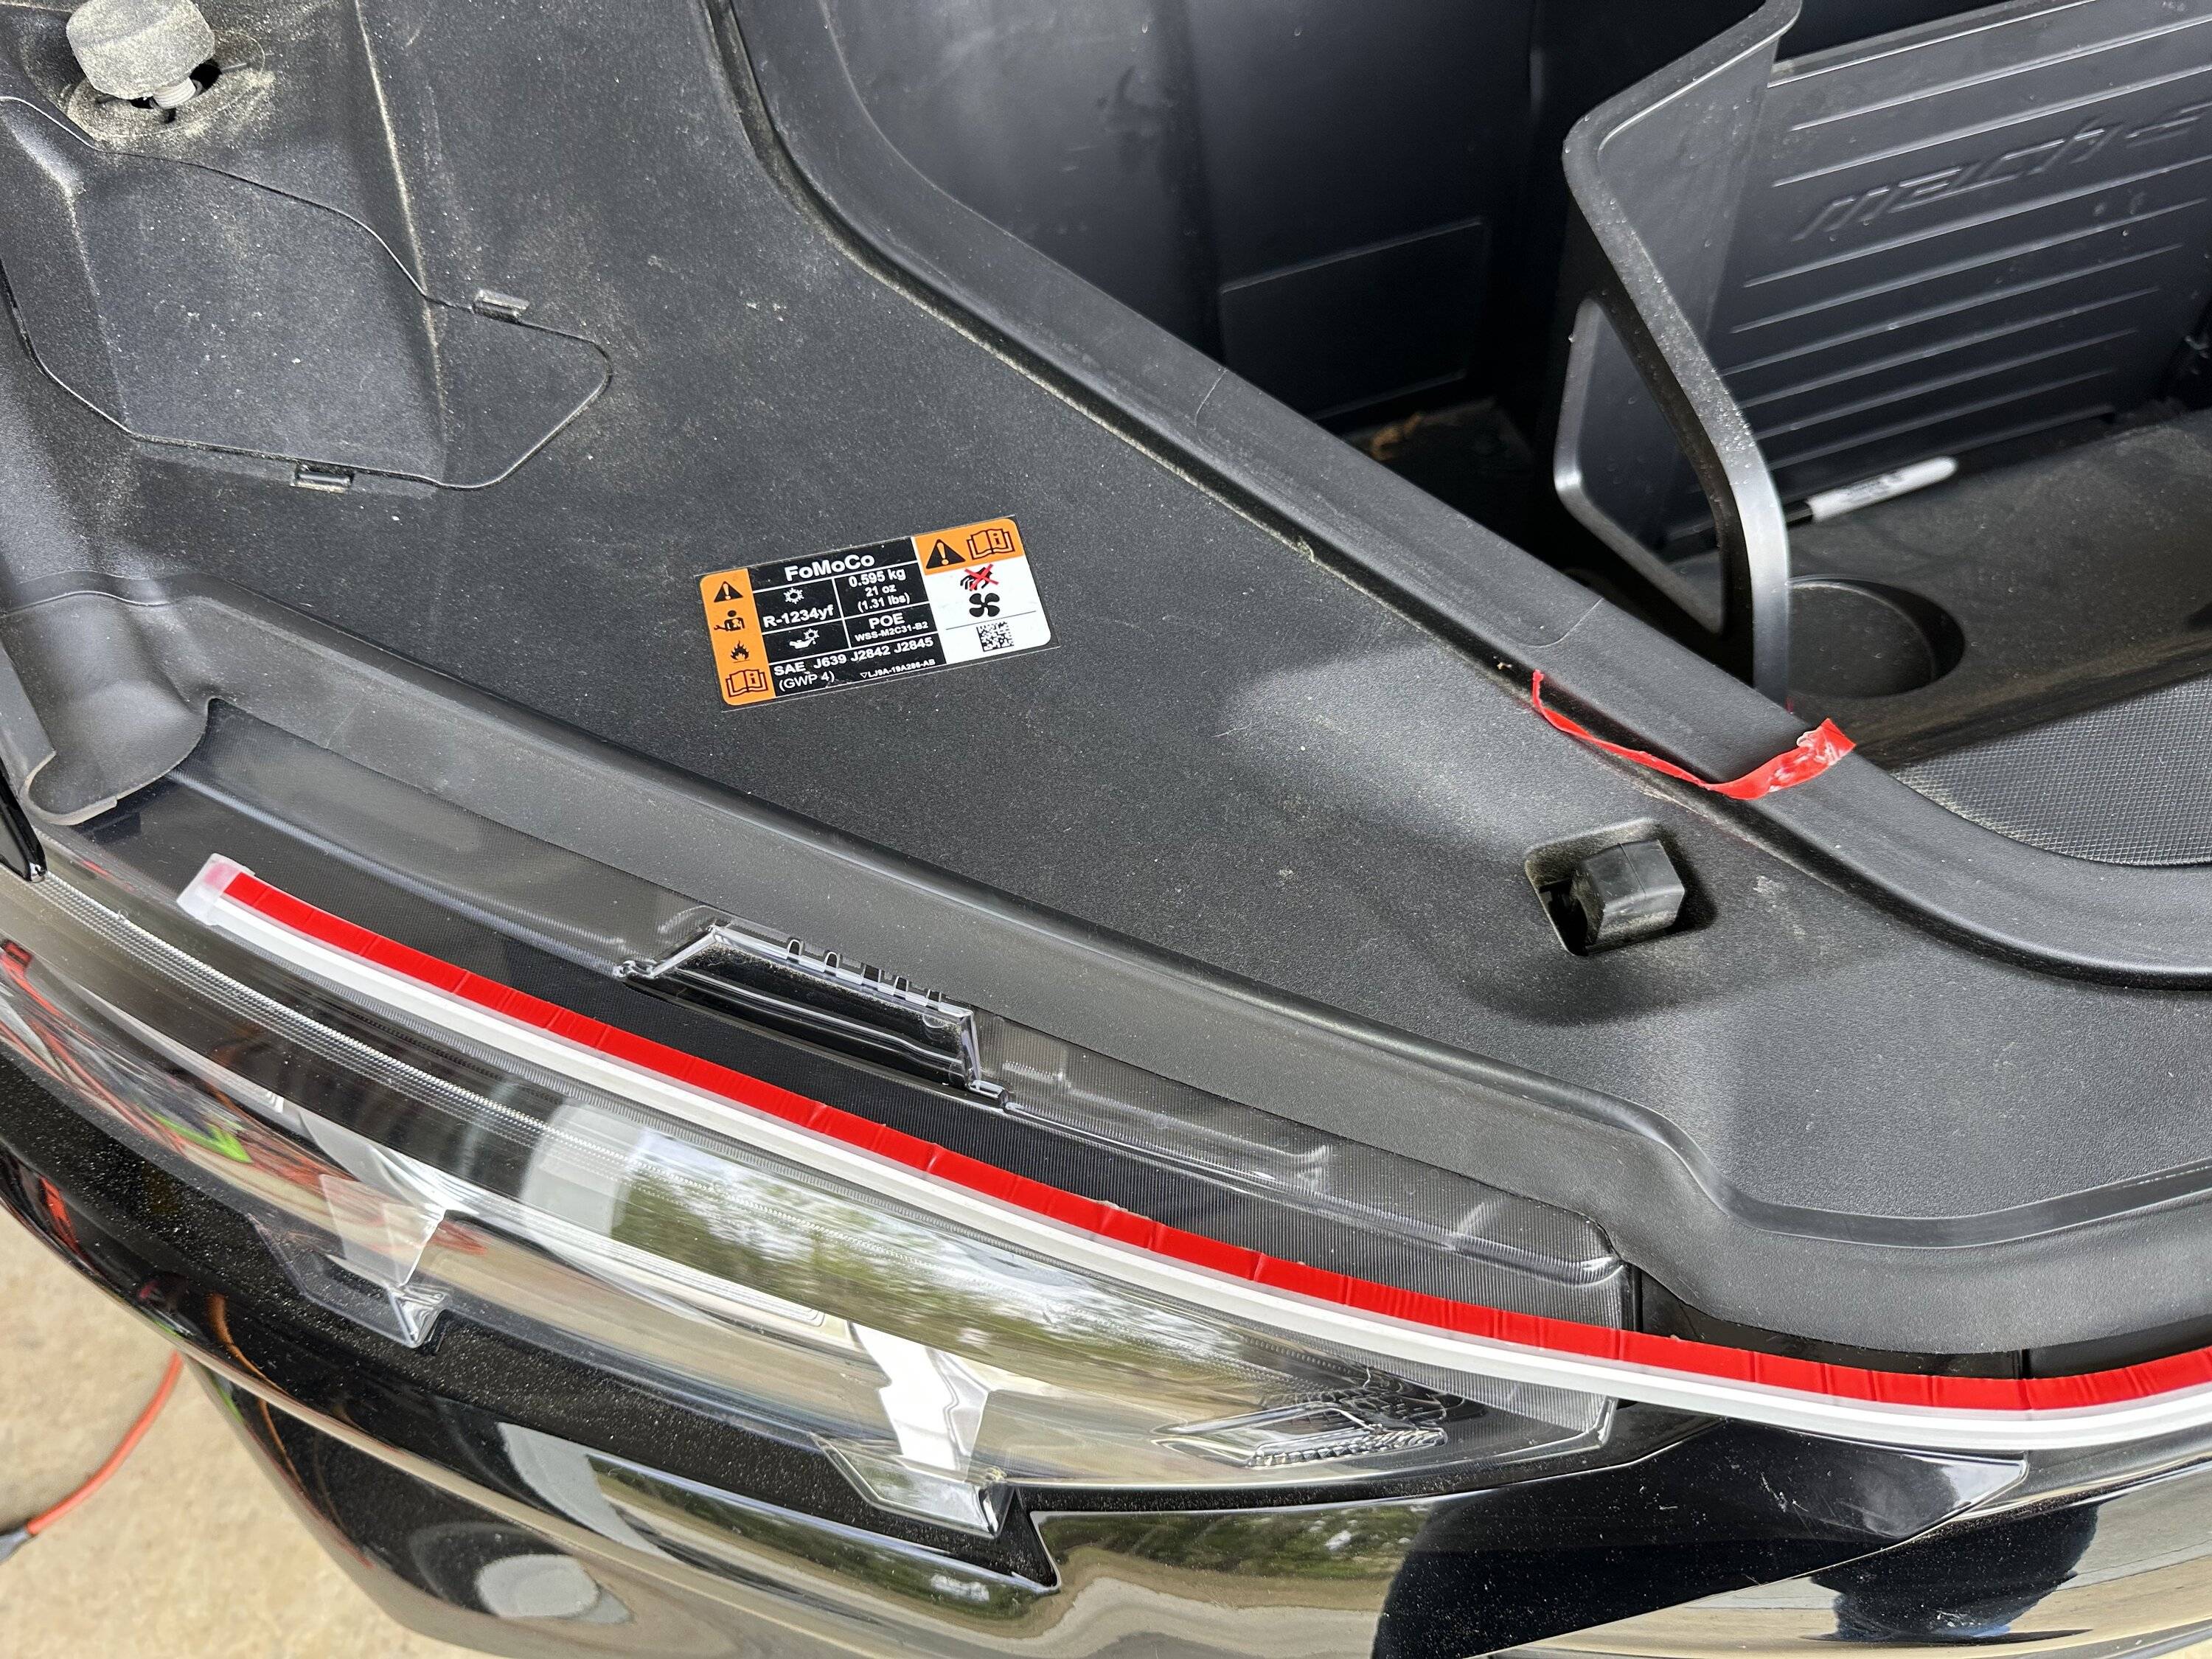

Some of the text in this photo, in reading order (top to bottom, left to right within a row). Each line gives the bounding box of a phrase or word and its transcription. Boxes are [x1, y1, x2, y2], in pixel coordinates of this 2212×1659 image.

[785, 554, 874, 582] FoMoCo
[849, 568, 906, 588] 0.595 kg
[866, 584, 896, 597] 21 oz
[857, 593, 911, 613] (1.31 lbs)
[762, 605, 834, 628] R-1234yf
[869, 613, 905, 629] POE
[774, 637, 933, 676] SAE J639 J2842 J2845
[778, 670, 835, 692] (GWP 4)
